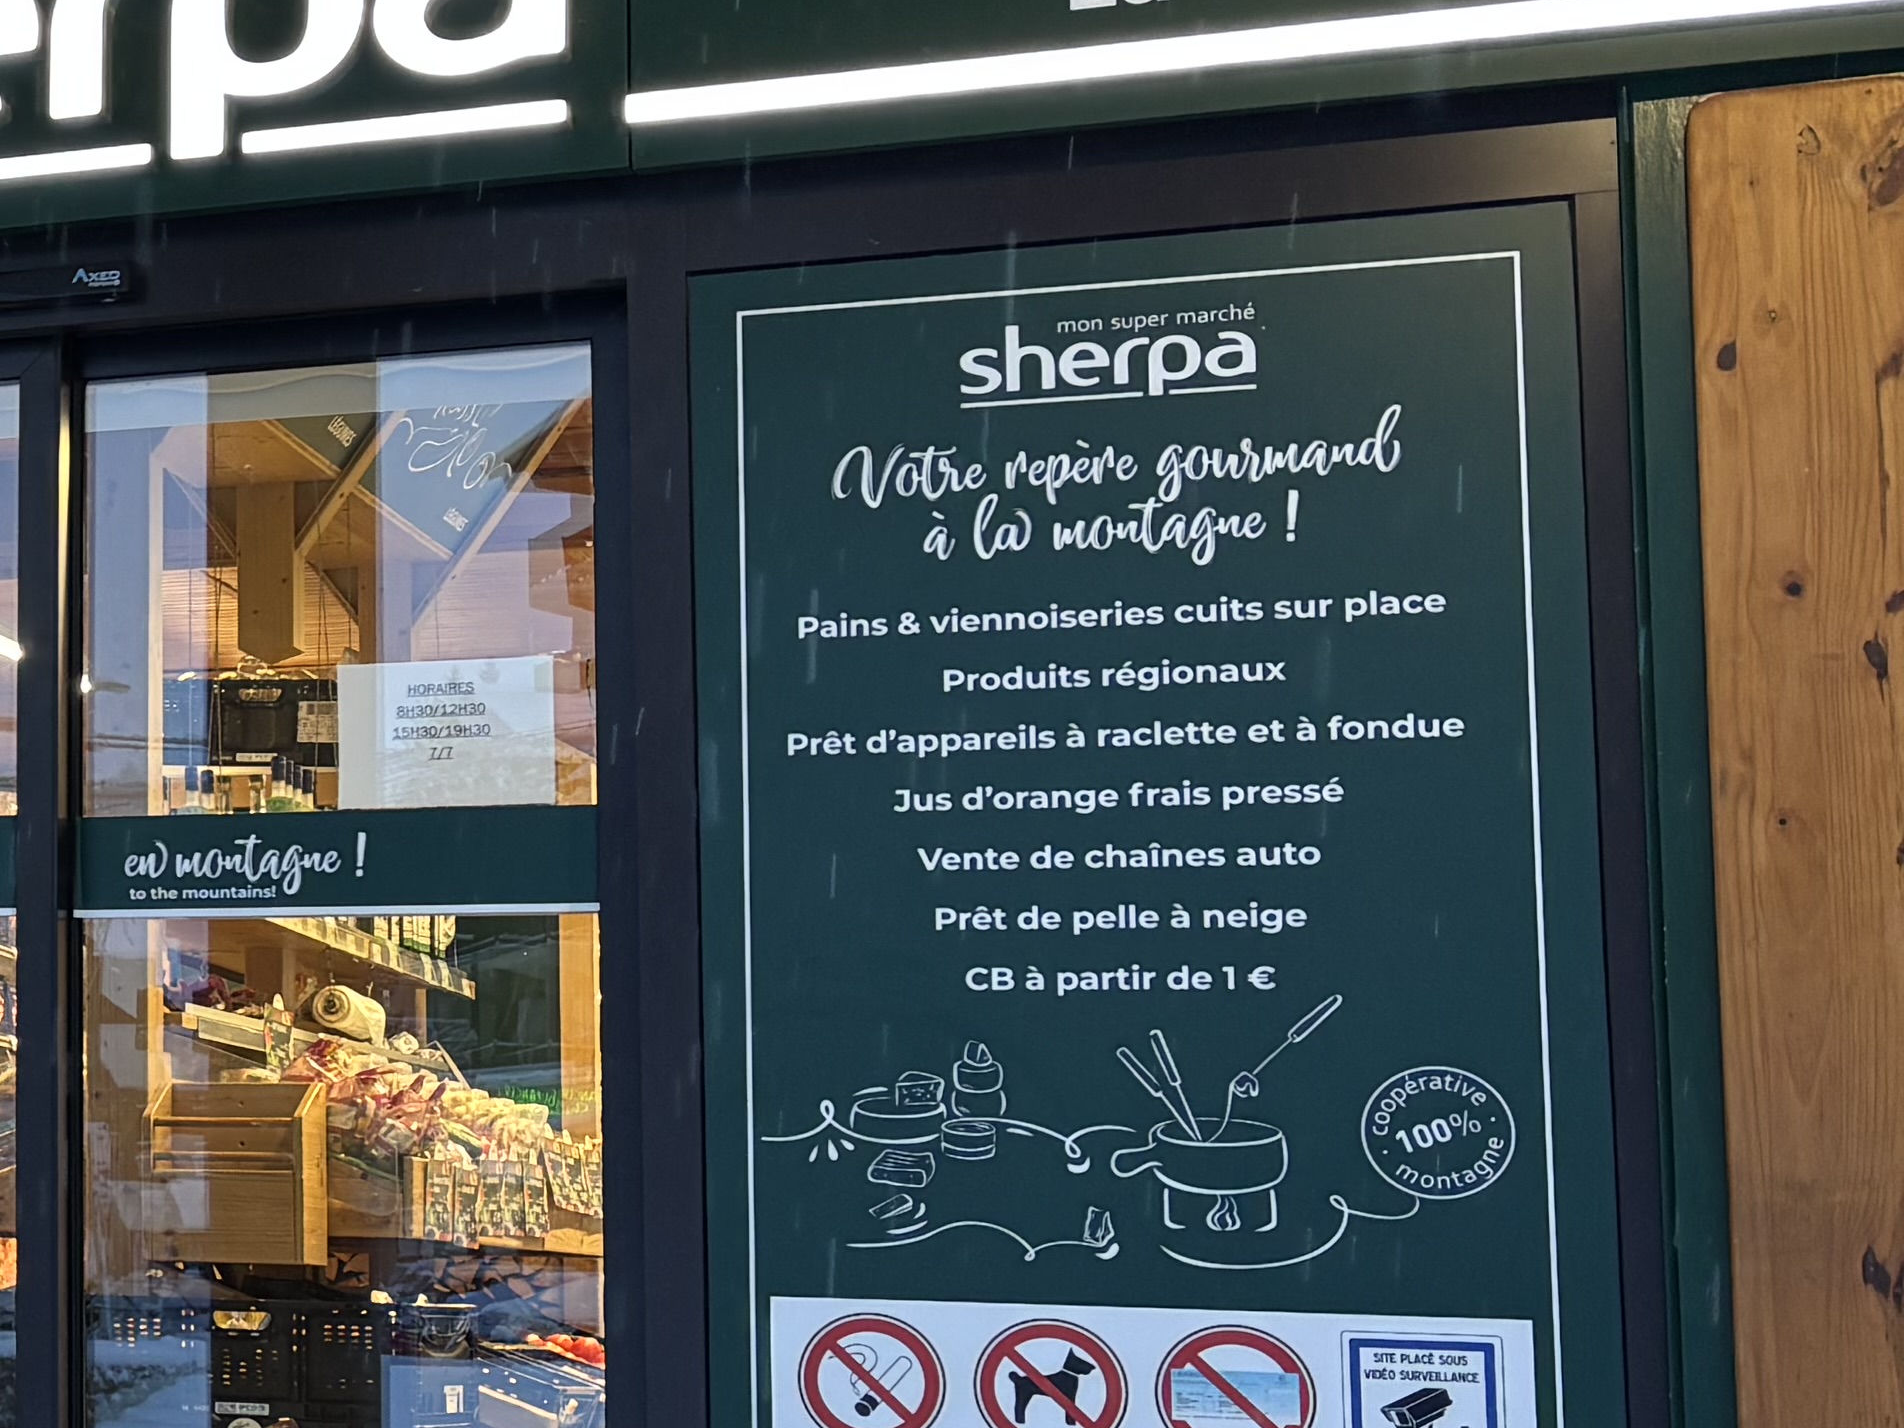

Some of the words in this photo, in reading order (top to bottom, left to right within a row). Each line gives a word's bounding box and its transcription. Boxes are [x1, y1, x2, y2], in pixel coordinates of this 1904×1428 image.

[1057, 318, 1104, 333] mon
[1110, 312, 1169, 332] super
[1176, 301, 1256, 325] marché
[958, 324, 1257, 396] sherpa
[832, 442, 986, 509] Votre
[1004, 439, 1137, 504] repère
[1155, 404, 1402, 503] gourmand
[923, 512, 955, 560] à
[973, 493, 1033, 560] la
[1052, 495, 1267, 565] montagne
[1285, 489, 1300, 542] !
[798, 612, 889, 639] Pains
[897, 611, 921, 635] &
[929, 600, 1165, 634] viennoiseries
[1174, 595, 1264, 624] cuits
[1274, 598, 1333, 620] sur
[1344, 590, 1447, 623] place
[407, 681, 475, 695] HORAIRES
[943, 663, 1091, 693] Produits
[1101, 658, 1286, 692] régionaux
[396, 702, 486, 718] 8H30/12H30
[393, 723, 491, 740] 15H30/19H30
[787, 730, 857, 756] Prêt
[866, 724, 1056, 760] d'appareils
[1066, 723, 1086, 748] à
[1097, 720, 1237, 747] raclette
[1247, 719, 1286, 743] et
[1296, 716, 1317, 742] à
[1327, 713, 1465, 741] fondue
[428, 746, 454, 760] 7/7
[893, 789, 953, 813] Jus
[962, 780, 1119, 816] d'orange
[1128, 779, 1211, 807] frais
[1222, 776, 1345, 811] pressé
[125, 840, 169, 878] en
[176, 833, 342, 895] montagne
[355, 831, 367, 878] !
[917, 847, 1020, 871] Vente
[1029, 844, 1075, 870] de
[1084, 842, 1226, 869] chaînes
[1236, 842, 1321, 866] auto
[129, 888, 147, 900] to
[150, 886, 178, 900] the
[182, 884, 277, 899] mountains!
[935, 905, 1008, 931] Prêt
[1017, 905, 1062, 930] de
[1073, 904, 1160, 936] pelle
[1170, 903, 1191, 929] à
[1203, 901, 1308, 934] neige
[965, 967, 1015, 991] CB
[1025, 965, 1045, 991] à
[1057, 964, 1157, 997] partir
[1166, 965, 1213, 990] de
[1221, 966, 1236, 990] 1
[1247, 965, 1276, 990] €
[1372, 1073, 1487, 1136] coopérative
[1395, 1110, 1482, 1154] 100%
[1395, 1136, 1505, 1190] montagne
[1364, 1368, 1396, 1381] VIDÉO
[1399, 1369, 1480, 1384] SURVEILLANCE
[1373, 1352, 1397, 1364] SITE
[1400, 1352, 1435, 1365] PLACÉ
[1438, 1354, 1468, 1366] SOUS
